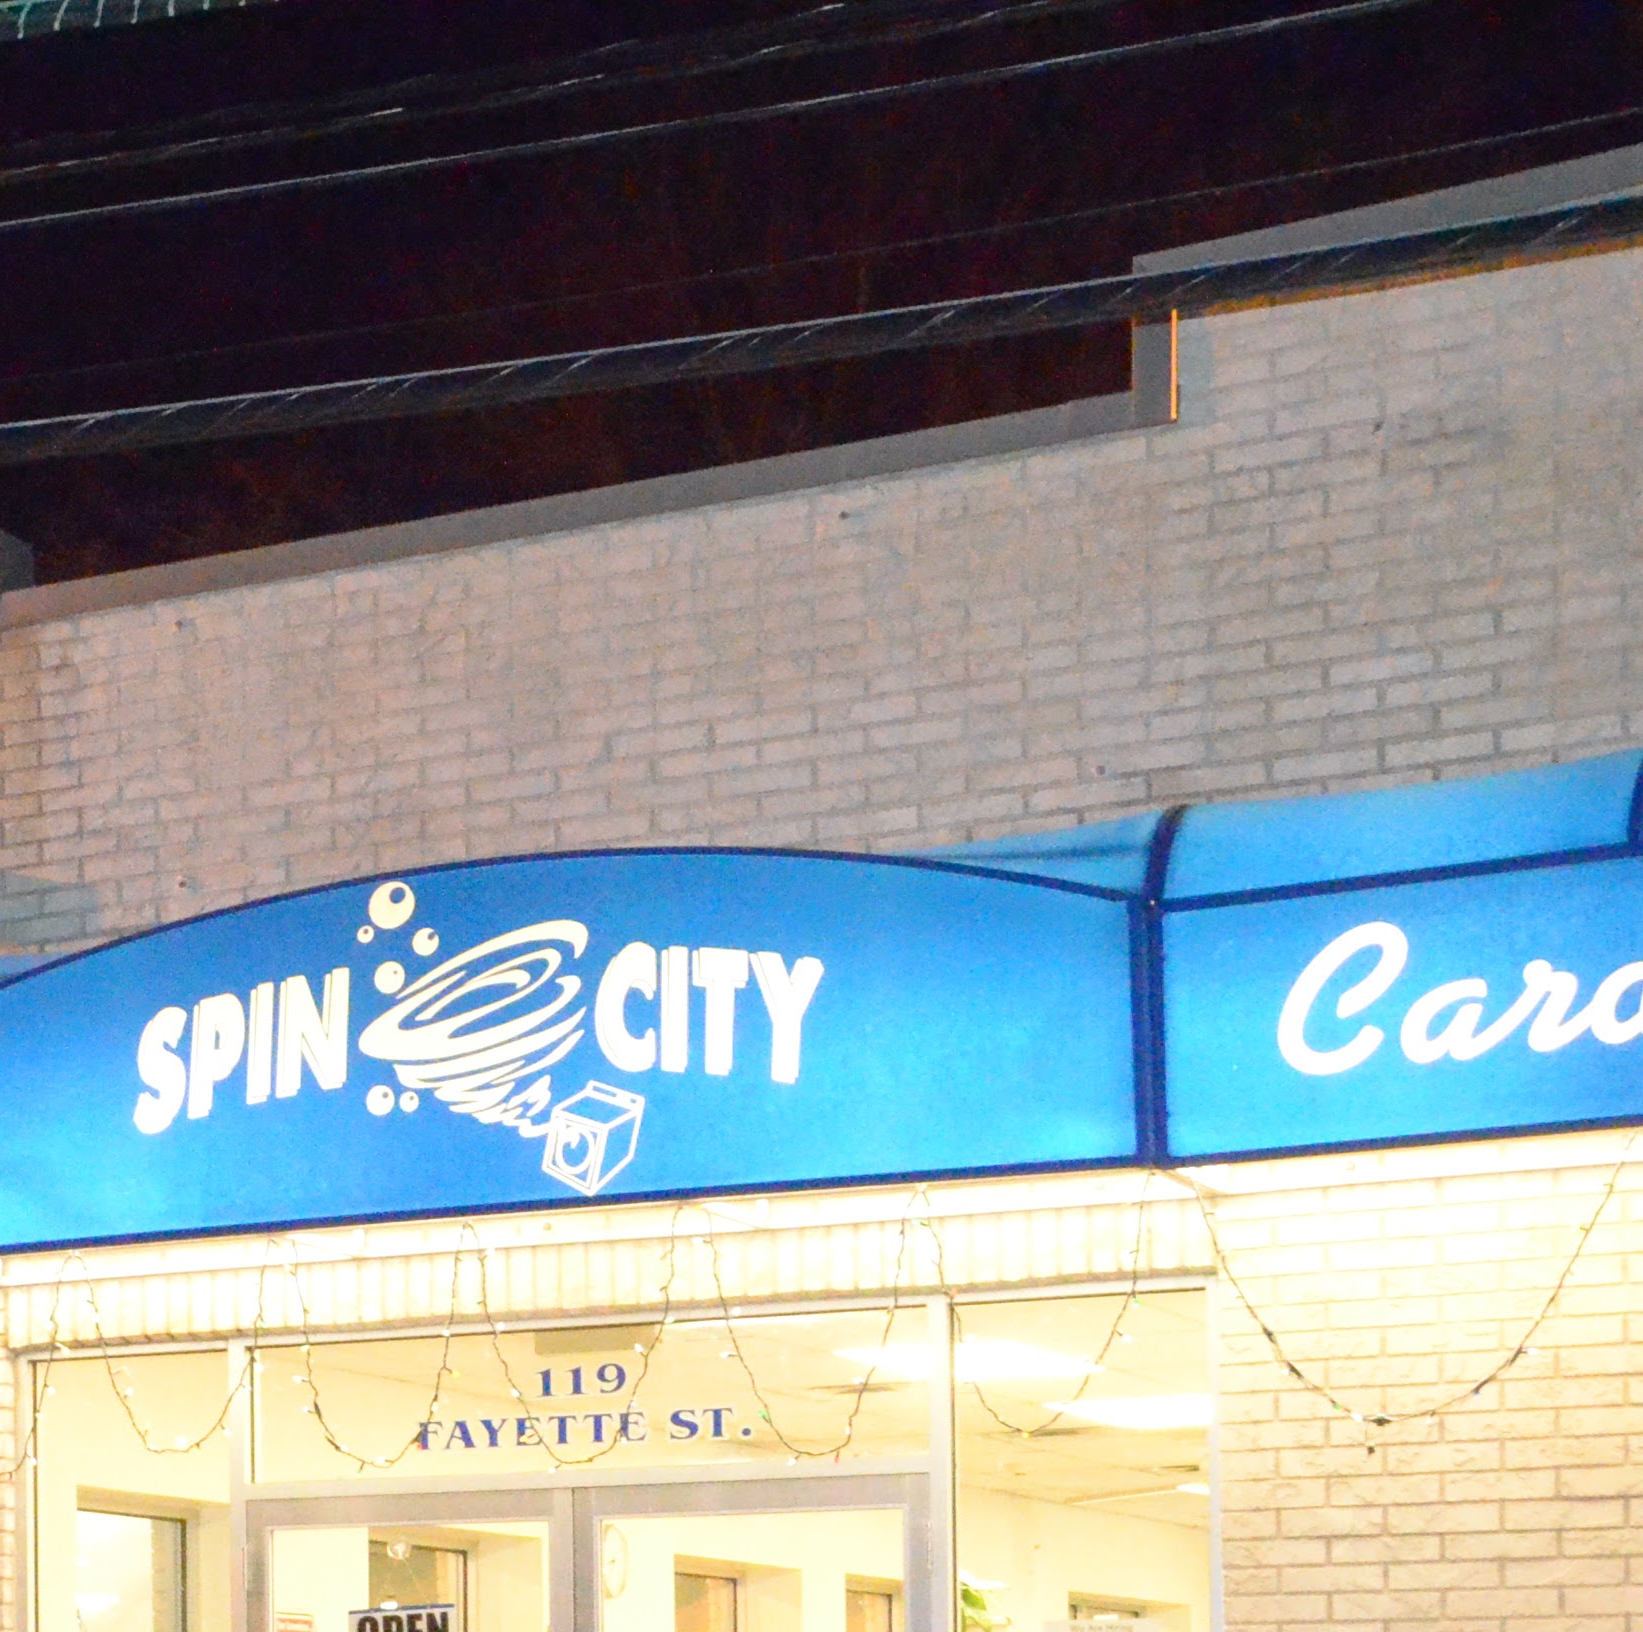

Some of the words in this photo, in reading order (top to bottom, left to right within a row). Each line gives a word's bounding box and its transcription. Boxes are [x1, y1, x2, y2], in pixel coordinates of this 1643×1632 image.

[132, 966, 350, 1134] SPIN
[595, 941, 824, 1084] CITY
[536, 1363, 626, 1397] 119
[418, 1412, 648, 1451] FAYETTE
[669, 1407, 752, 1439] ST.
